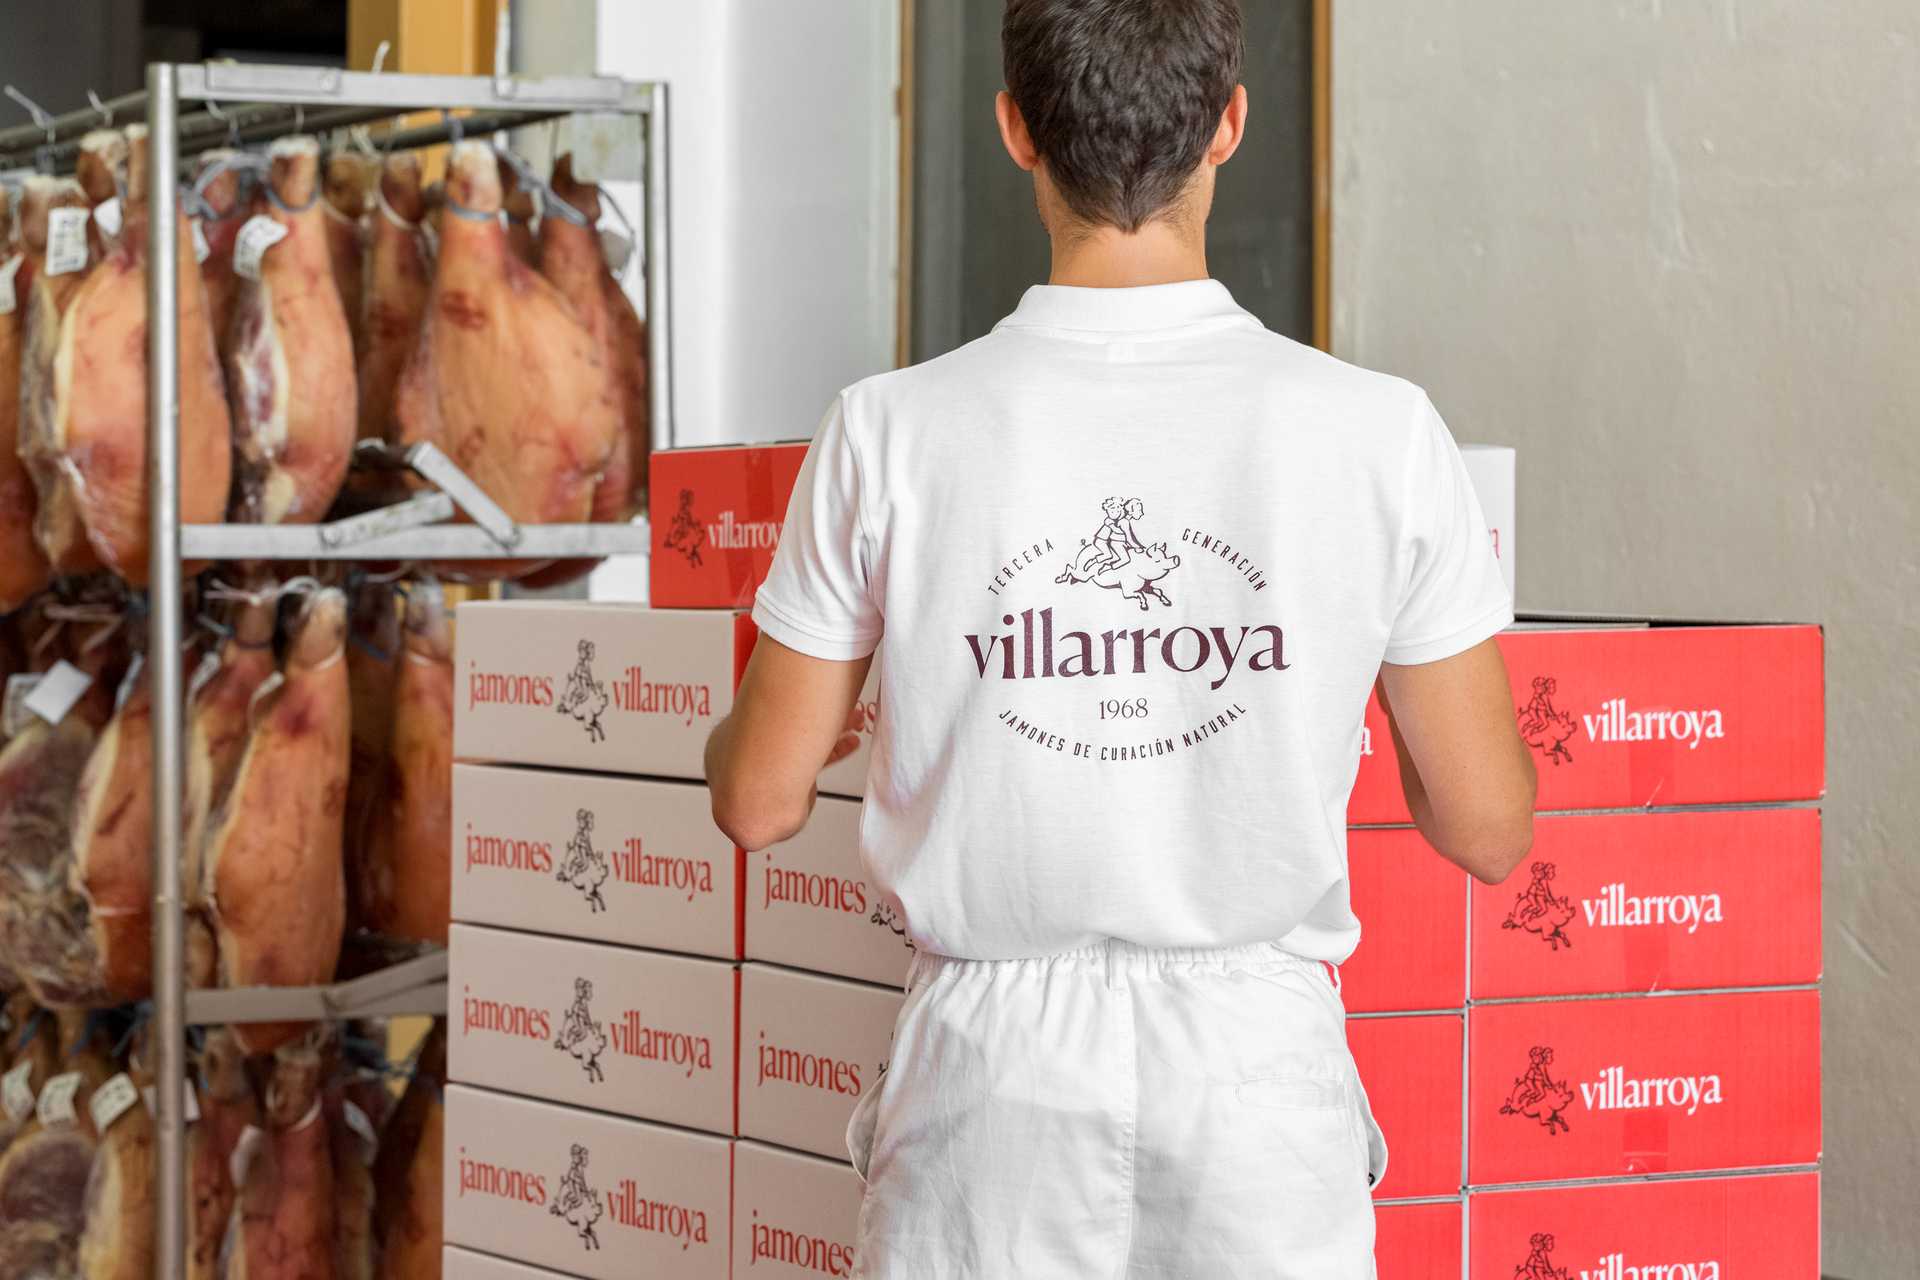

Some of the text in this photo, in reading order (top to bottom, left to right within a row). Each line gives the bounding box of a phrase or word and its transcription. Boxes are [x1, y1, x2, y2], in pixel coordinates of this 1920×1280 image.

[988, 528, 1267, 595] TERCERA GENERACIÓN
[964, 607, 1291, 690] villarroya
[469, 660, 711, 727] jamones villarroya
[1099, 698, 1149, 720] 1968
[1583, 698, 1724, 749] villarroya
[999, 703, 1247, 761] JAMONES DE CURACIÓN NATURAL
[466, 823, 712, 901] jamones villarroya
[764, 853, 867, 914] jamones
[1582, 883, 1723, 934] villarroya
[463, 985, 712, 1078] jamones villarroya
[758, 1030, 861, 1096] jamones
[1580, 1066, 1723, 1115] villarroya
[458, 1147, 708, 1250] jamones villarroya
[751, 1209, 855, 1279] jamones
